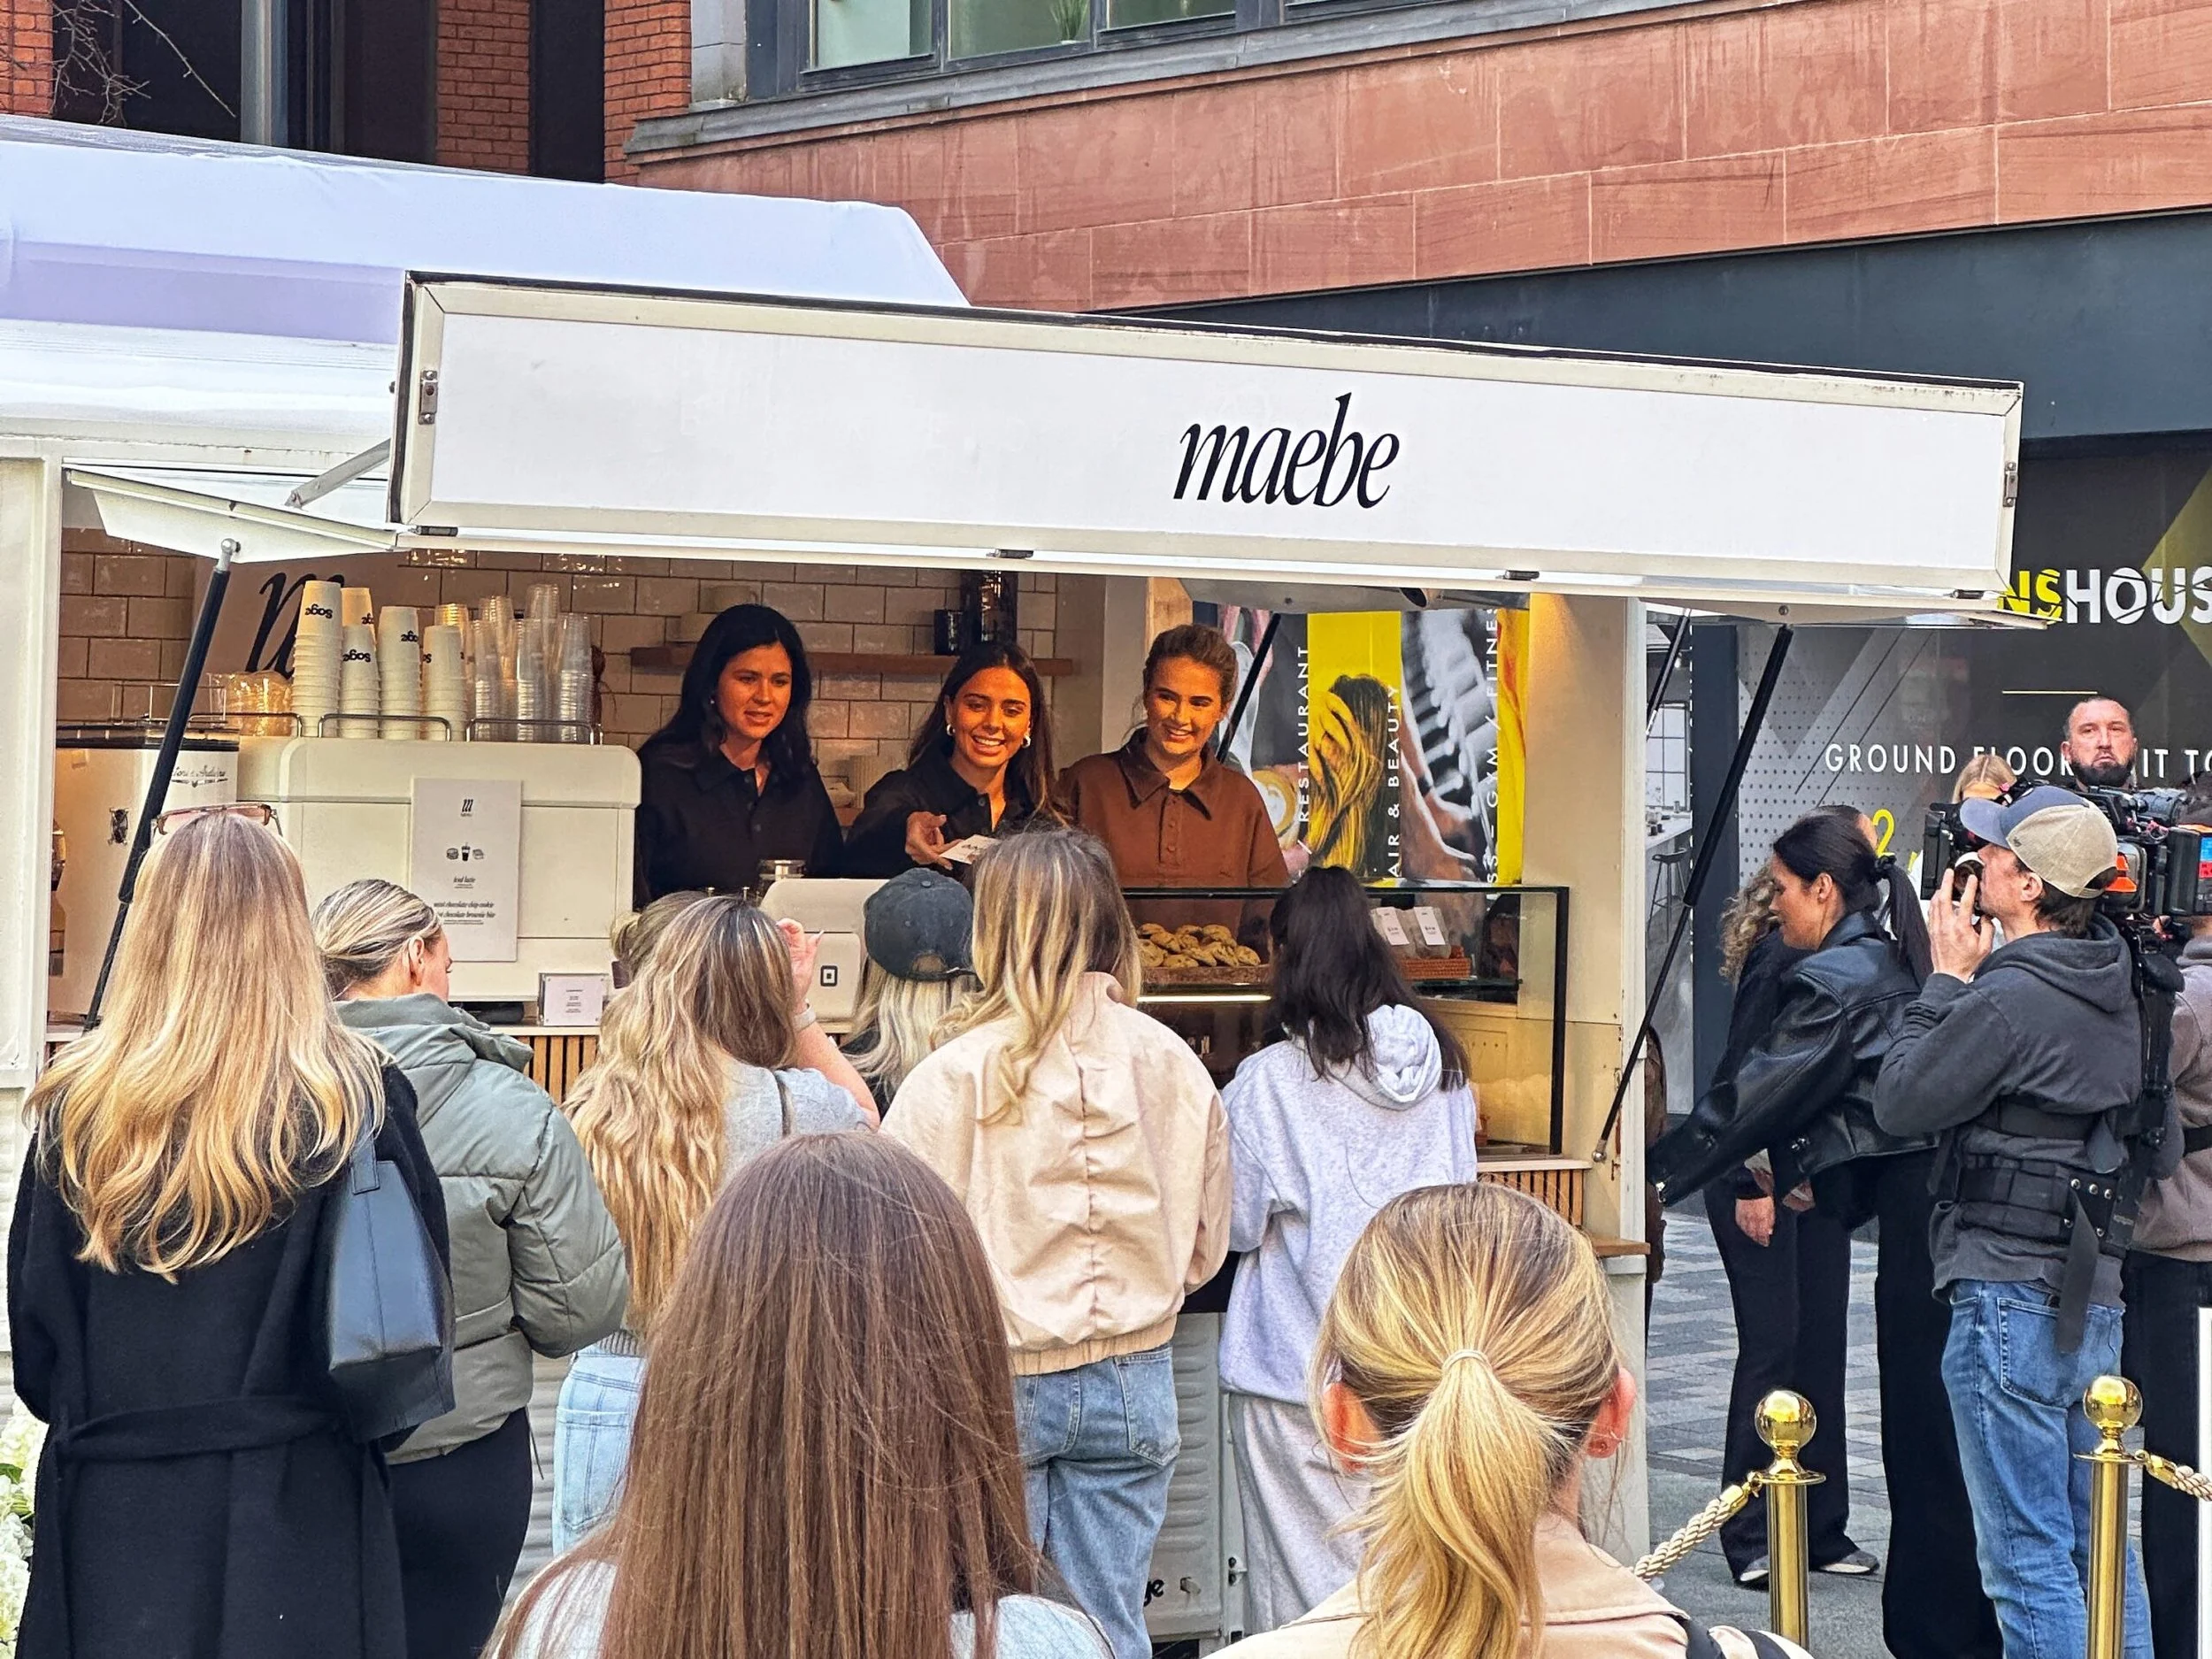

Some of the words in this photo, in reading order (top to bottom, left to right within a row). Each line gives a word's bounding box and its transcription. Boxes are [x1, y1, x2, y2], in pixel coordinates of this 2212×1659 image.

[1173, 392, 1400, 509] maebe
[1297, 647, 1310, 823] RESTAURANT
[1387, 685, 1400, 787] BEAUTY
[1824, 742, 1956, 776] GROUND
[1387, 803, 1400, 818] &
[1486, 749, 1498, 808] GYM
